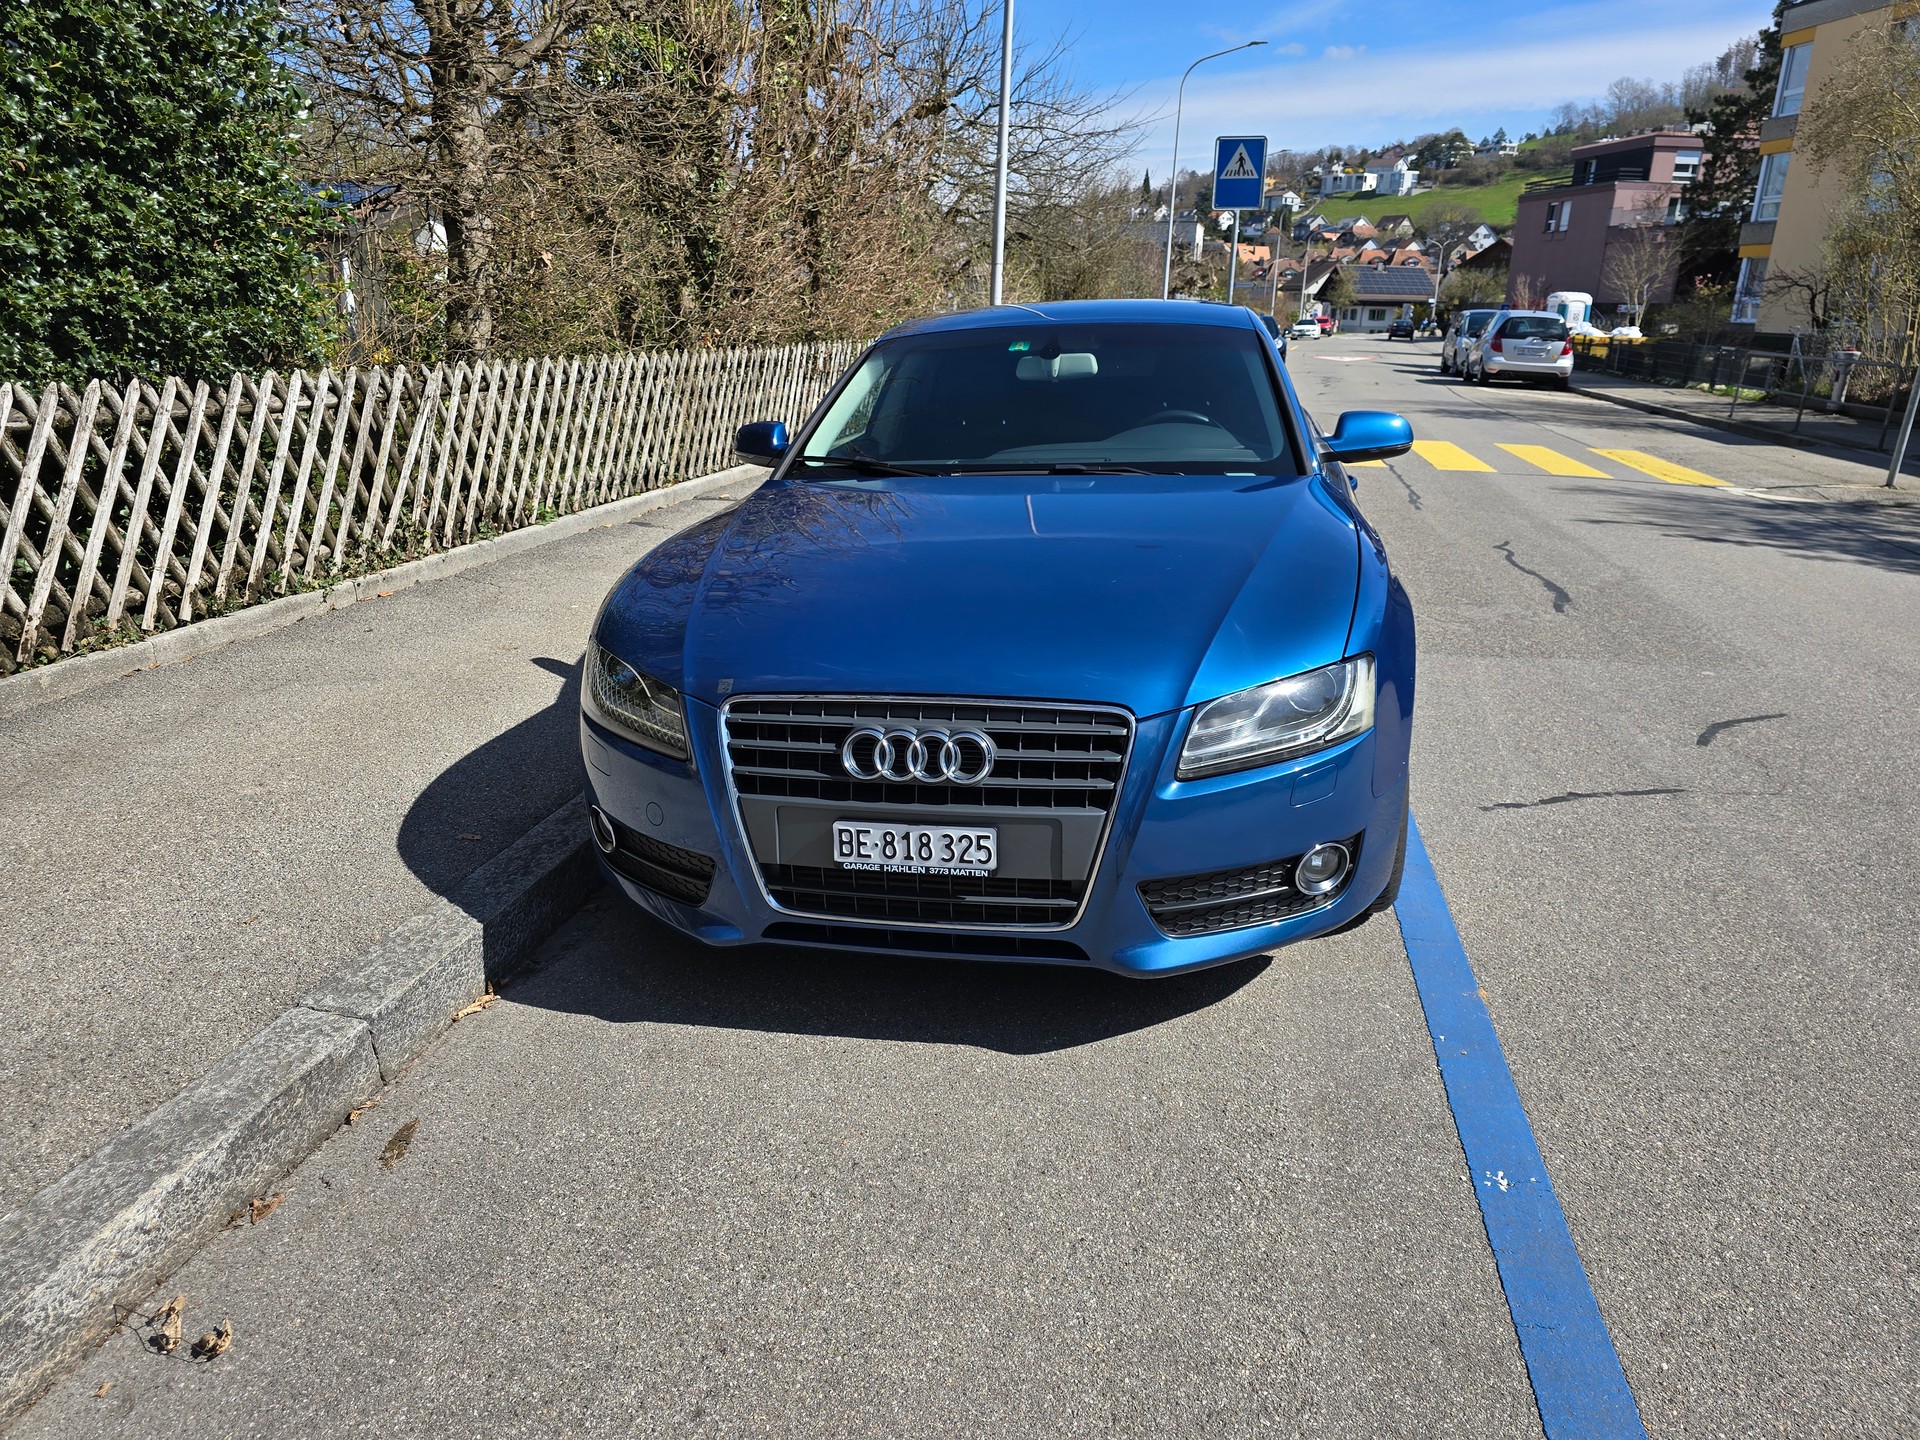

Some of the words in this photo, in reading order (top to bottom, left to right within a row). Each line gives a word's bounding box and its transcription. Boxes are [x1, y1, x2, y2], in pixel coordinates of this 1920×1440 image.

[941, 833, 992, 864] 325
[843, 862, 881, 871] GARAGE
[884, 864, 926, 874] HÄHLEN
[950, 868, 988, 877] MATTEN
